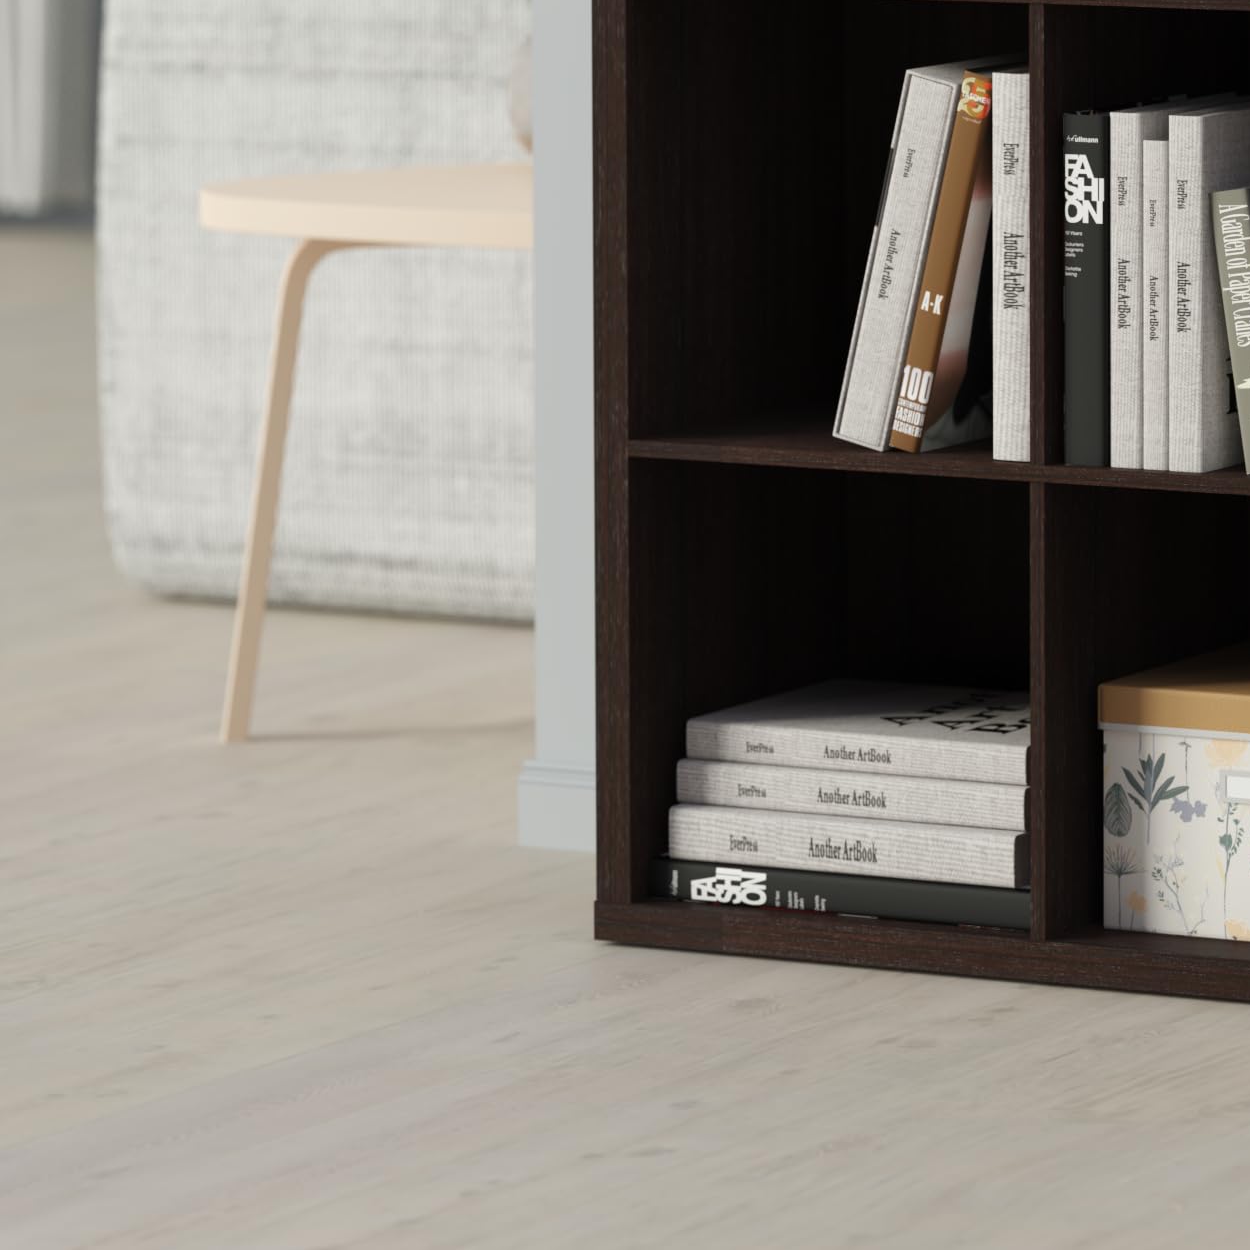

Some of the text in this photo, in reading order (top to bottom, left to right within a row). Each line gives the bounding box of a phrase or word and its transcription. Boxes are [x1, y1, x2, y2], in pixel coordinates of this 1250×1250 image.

[903, 147, 916, 178] EverPress
[1003, 143, 1020, 176] EverPress
[1117, 176, 1128, 206] EverPress
[1177, 179, 1188, 210] EverPress
[1149, 199, 1157, 227] EverPress
[1218, 204, 1249, 215] A
[878, 228, 901, 300] Another ArtBook
[1003, 231, 1025, 310] Another ArtBook
[1117, 257, 1132, 330] Another ArtBook
[1149, 275, 1160, 341] Another ArtBook
[1177, 261, 1192, 333] Another ArtBook
[900, 364, 934, 405] 100
[894, 406, 926, 427] FASHION
[823, 744, 892, 764] Another ArtBook
[817, 787, 887, 808] Another ArtBook
[808, 837, 878, 863] Another ArtBook
